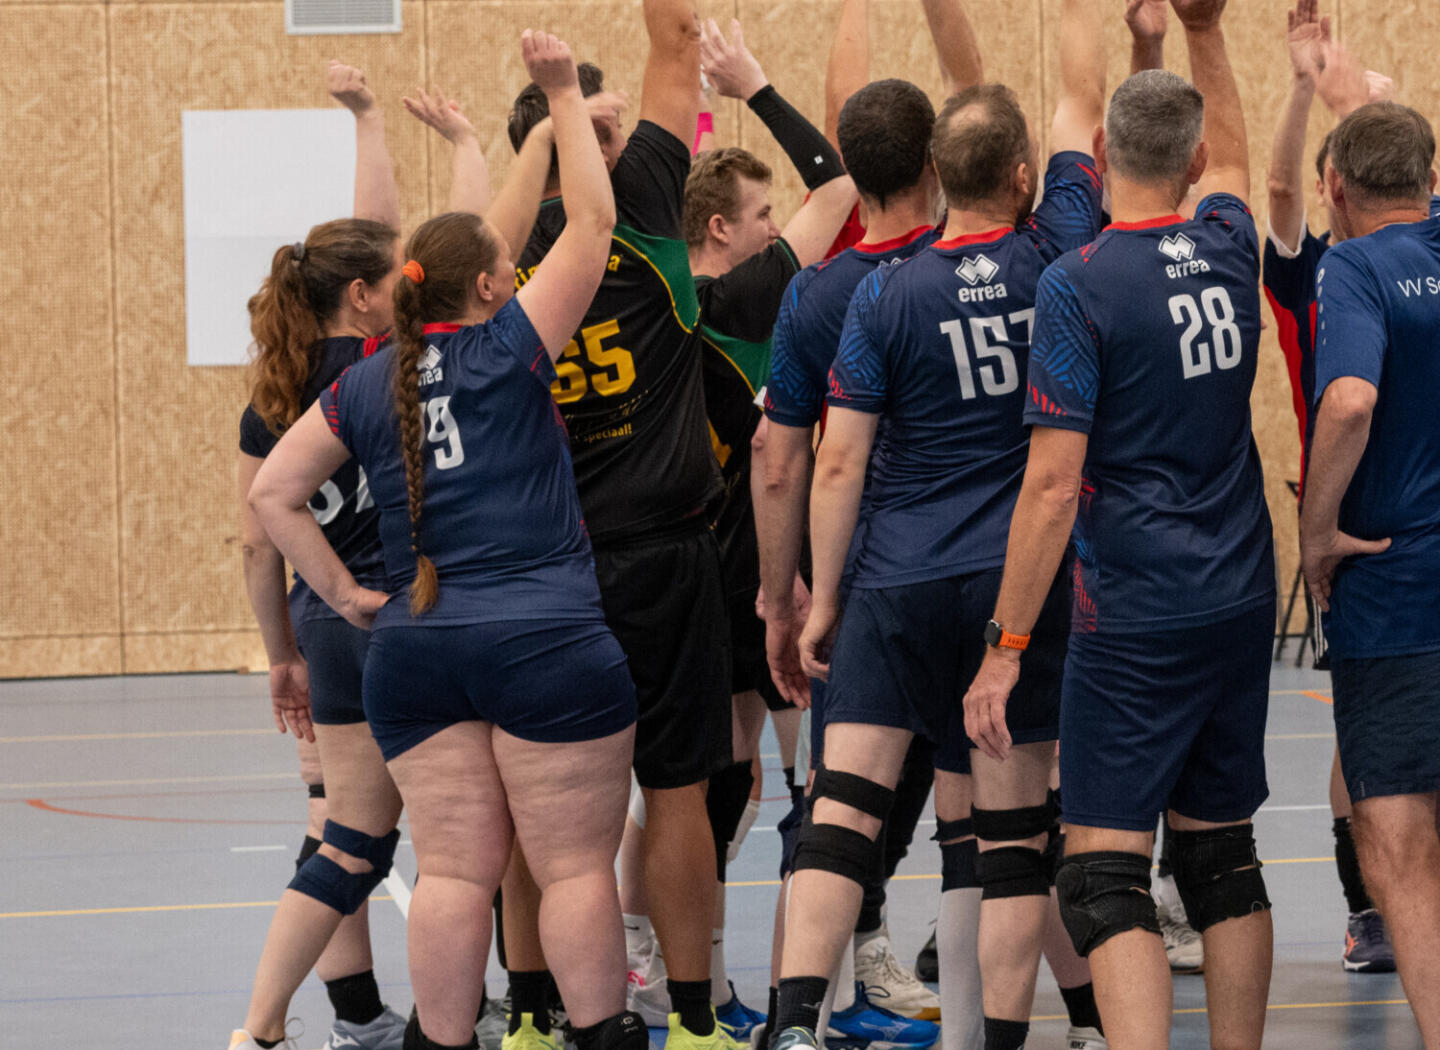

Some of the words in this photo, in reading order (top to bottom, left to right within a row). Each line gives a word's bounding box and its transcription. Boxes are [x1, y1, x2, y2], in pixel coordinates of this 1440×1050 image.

[1166, 259, 1210, 279] errea
[958, 282, 1008, 303] errea
[1397, 277, 1421, 298] VV
[1168, 286, 1242, 380] 28
